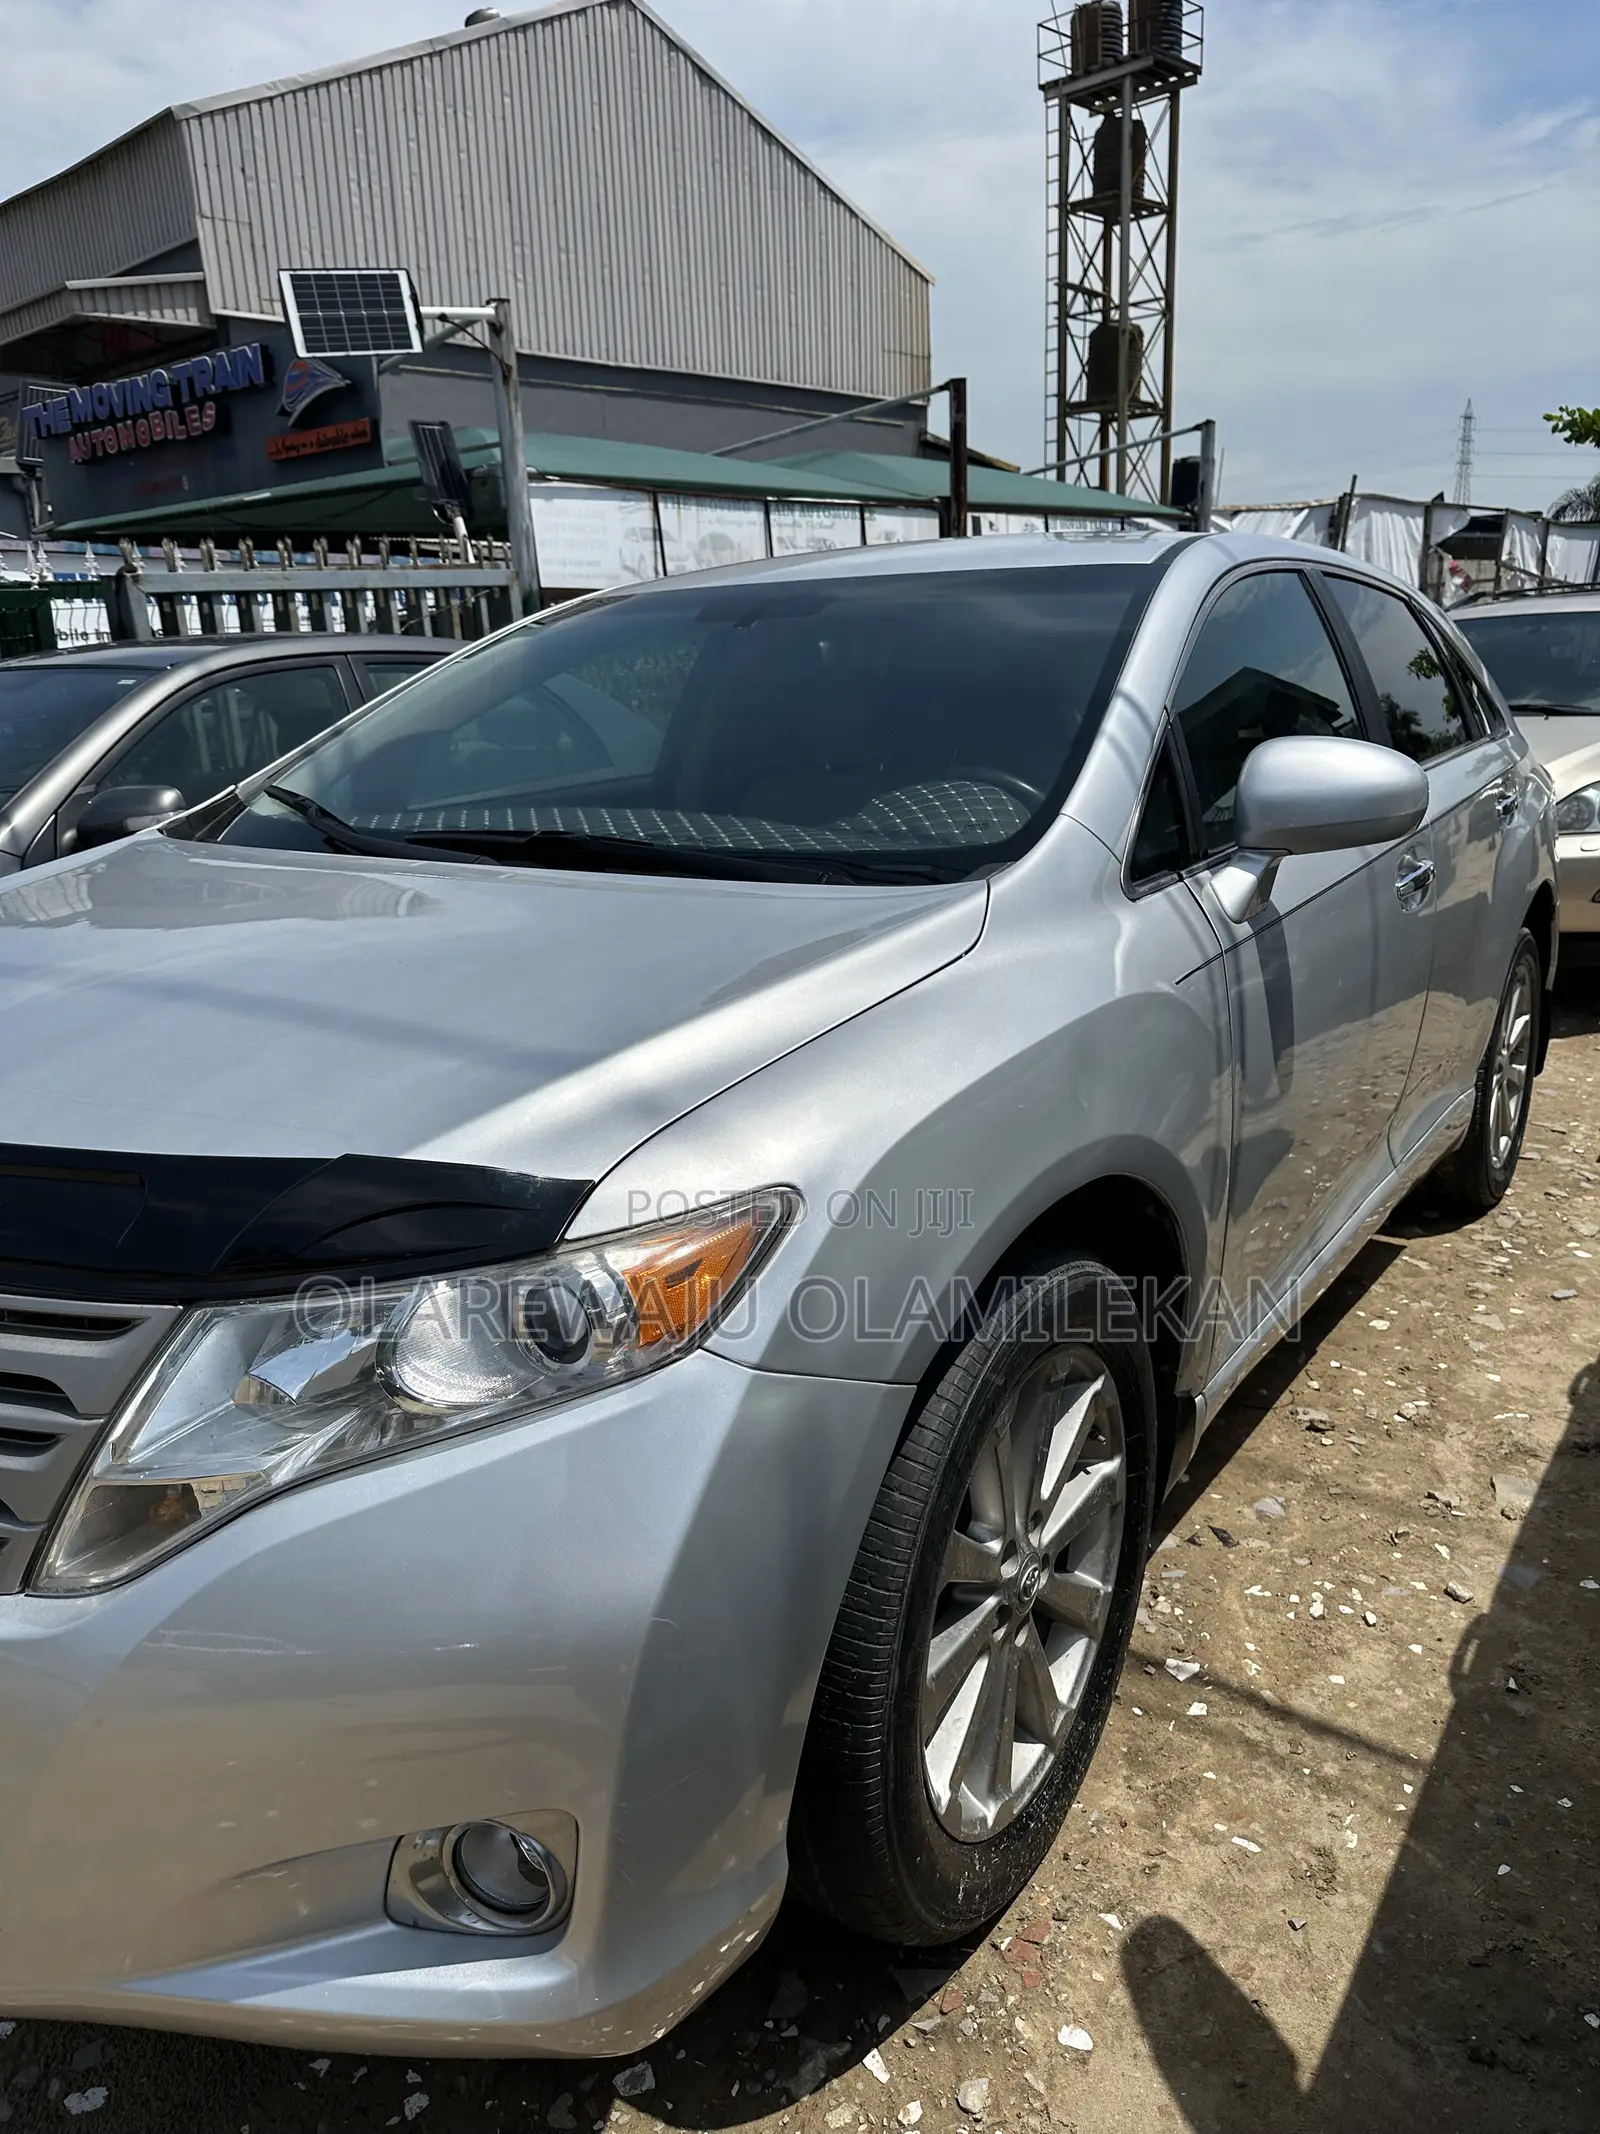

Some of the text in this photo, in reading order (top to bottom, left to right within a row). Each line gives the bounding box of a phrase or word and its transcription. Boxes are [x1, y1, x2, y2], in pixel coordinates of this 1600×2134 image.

[22, 396, 72, 438] THE
[68, 368, 174, 424] MOVING
[171, 343, 264, 400] TRAIN
[68, 401, 216, 463] AUTOMOBILES
[56, 627, 89, 642] bile
